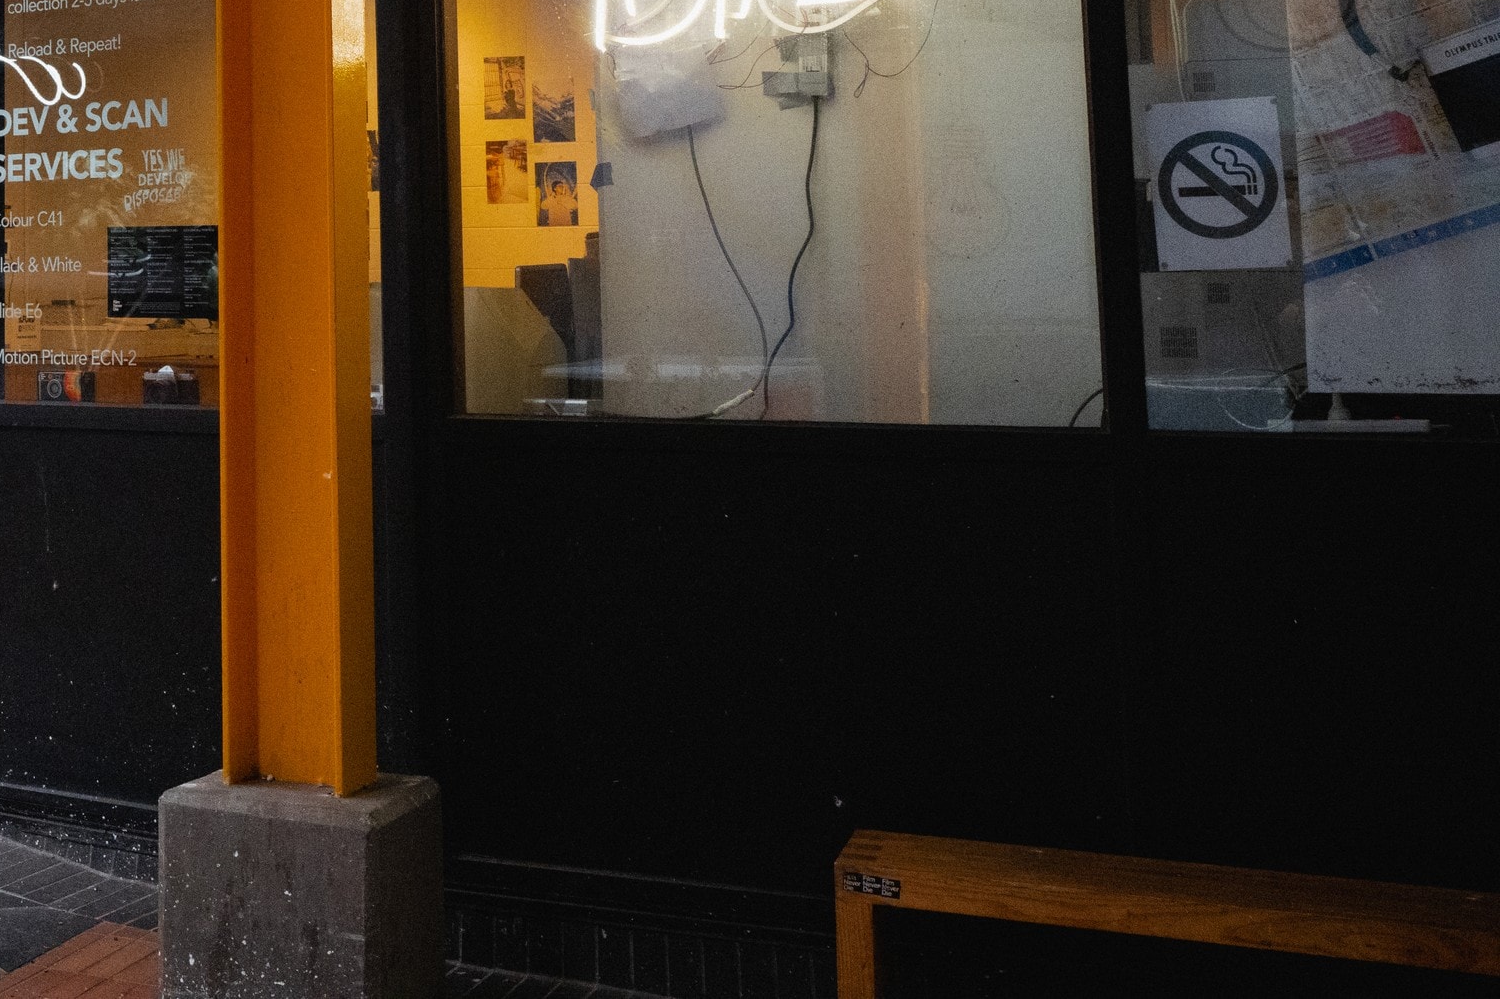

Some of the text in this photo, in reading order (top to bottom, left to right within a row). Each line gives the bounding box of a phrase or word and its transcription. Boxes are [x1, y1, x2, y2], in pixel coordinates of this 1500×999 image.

[8, 34, 121, 58] Reload & Repeat!
[1444, 38, 1482, 58] OLYMPUS
[57, 104, 78, 134] &
[85, 98, 168, 132] SCAN
[141, 148, 186, 172] YES WE
[138, 172, 192, 186] DEVELOP
[124, 187, 190, 212] DISPOSAB
[37, 210, 63, 226] C41
[28, 257, 39, 272] &
[42, 256, 82, 272] White
[26, 302, 42, 319] E6
[42, 348, 87, 365] Picture
[92, 350, 137, 366] ECN-2
